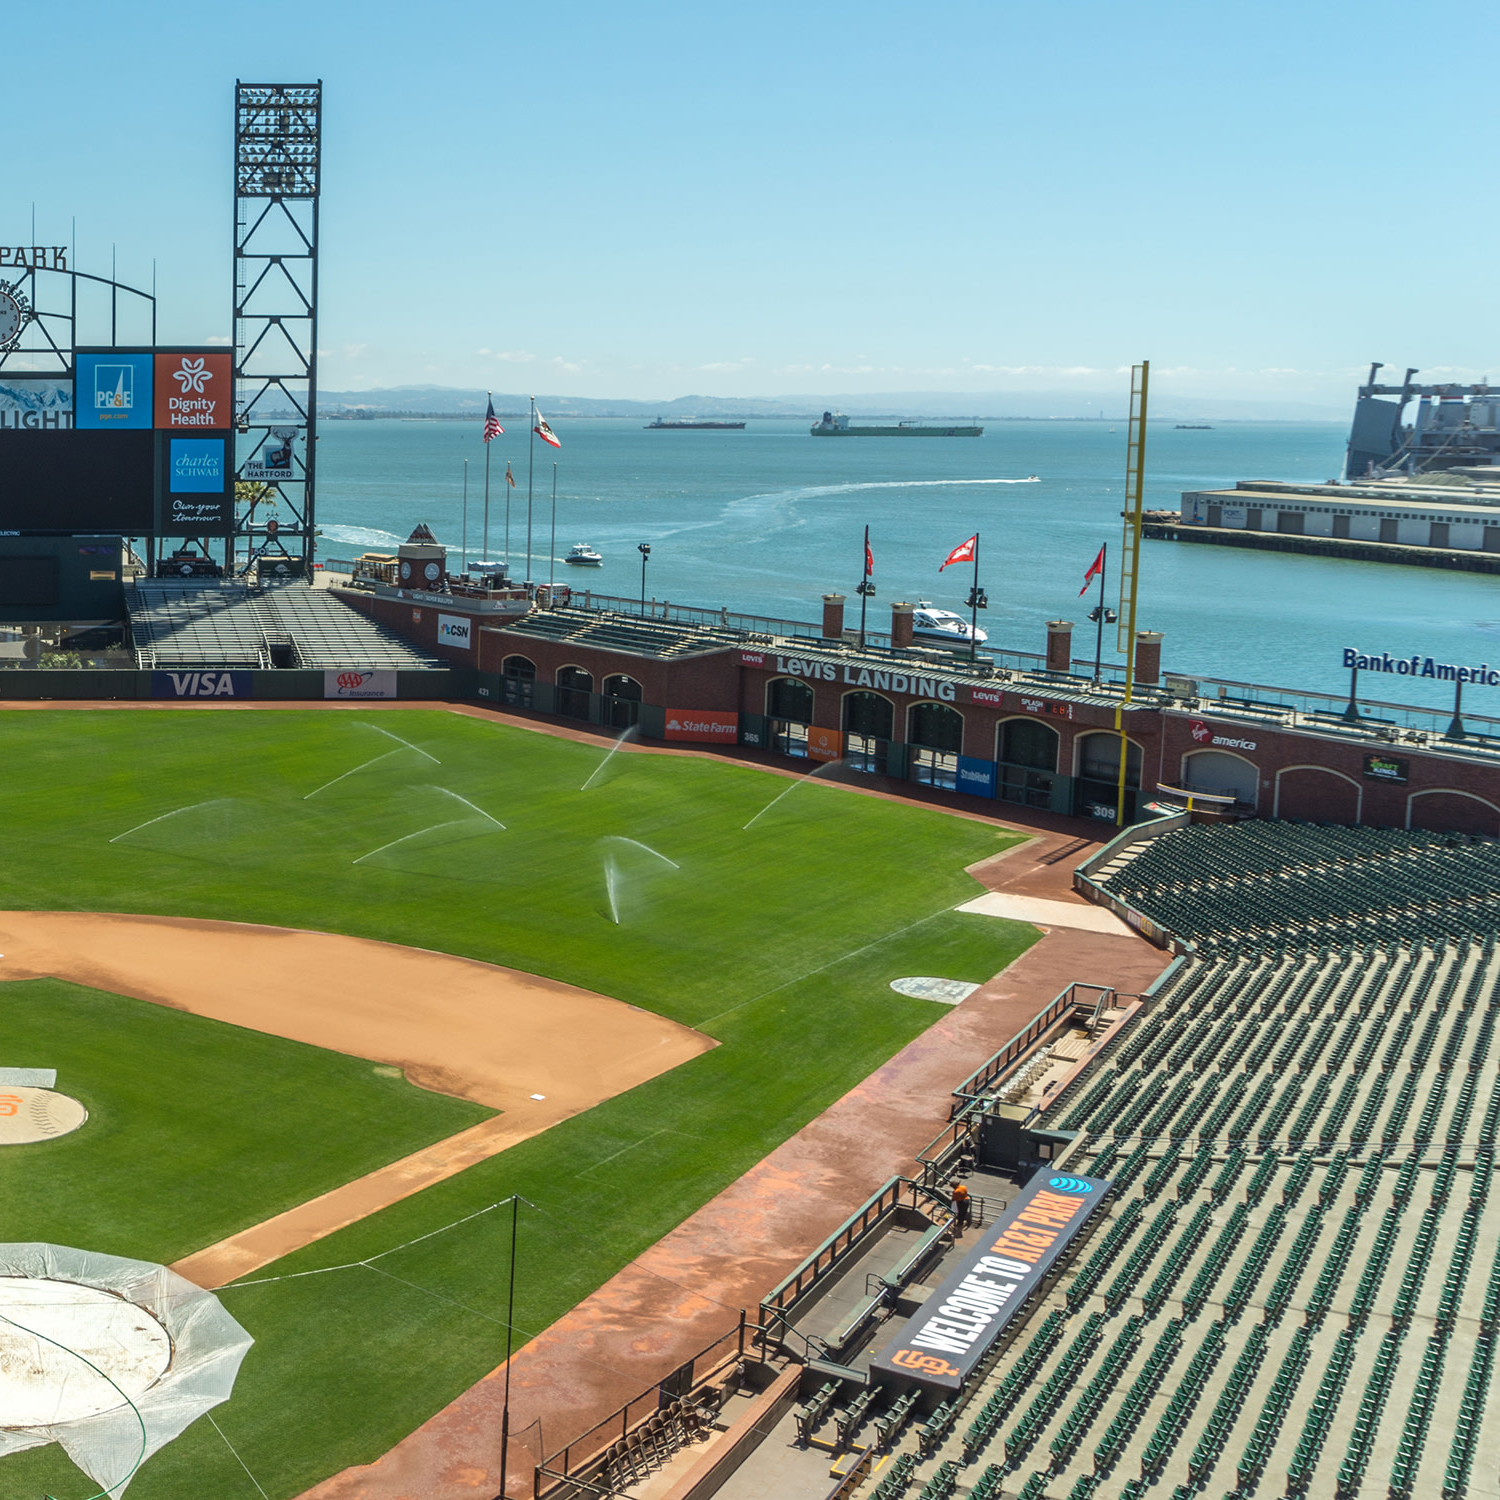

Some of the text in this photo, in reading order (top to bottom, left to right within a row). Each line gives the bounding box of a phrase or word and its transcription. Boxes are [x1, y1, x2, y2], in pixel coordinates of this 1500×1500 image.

[96, 390, 131, 407] PG&E
[168, 397, 216, 414] Dignity
[0, 410, 73, 430] LIGHT
[170, 412, 215, 425] Health
[175, 452, 219, 467] charles
[247, 462, 264, 470] THE
[175, 467, 219, 477] SCHWAB
[247, 470, 292, 478] HARTFORD
[450, 624, 469, 638] CSN
[1343, 647, 1500, 687] Bank of Americ
[166, 672, 235, 696] VISA
[337, 672, 363, 689] AAA
[843, 666, 956, 702] LANDING
[477, 687, 490, 697] 421
[1021, 698, 1044, 708] SPLASH
[682, 720, 737, 734] State Farm
[744, 732, 760, 743] 365
[1211, 735, 1257, 751] america
[1093, 805, 1116, 819] 309
[910, 1189, 1086, 1355] WELCOME TO AT&T PARK
